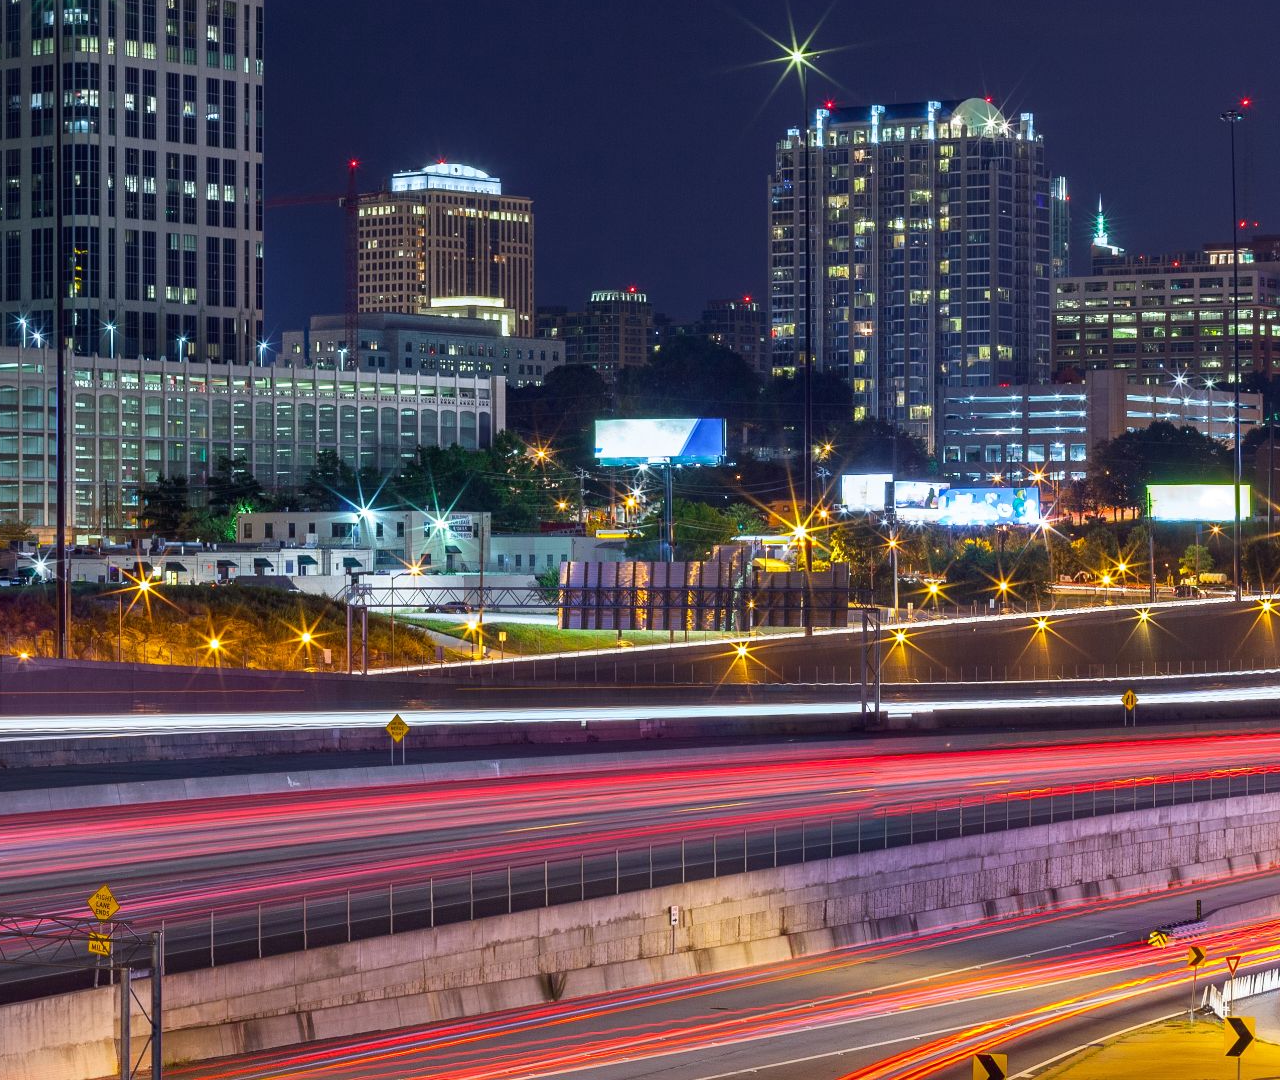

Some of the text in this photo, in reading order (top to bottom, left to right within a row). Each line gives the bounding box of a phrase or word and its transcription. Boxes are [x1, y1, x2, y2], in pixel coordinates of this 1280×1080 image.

[96, 894, 112, 902] RIGHT
[96, 902, 110, 910] LANE
[96, 908, 110, 917] ENDS
